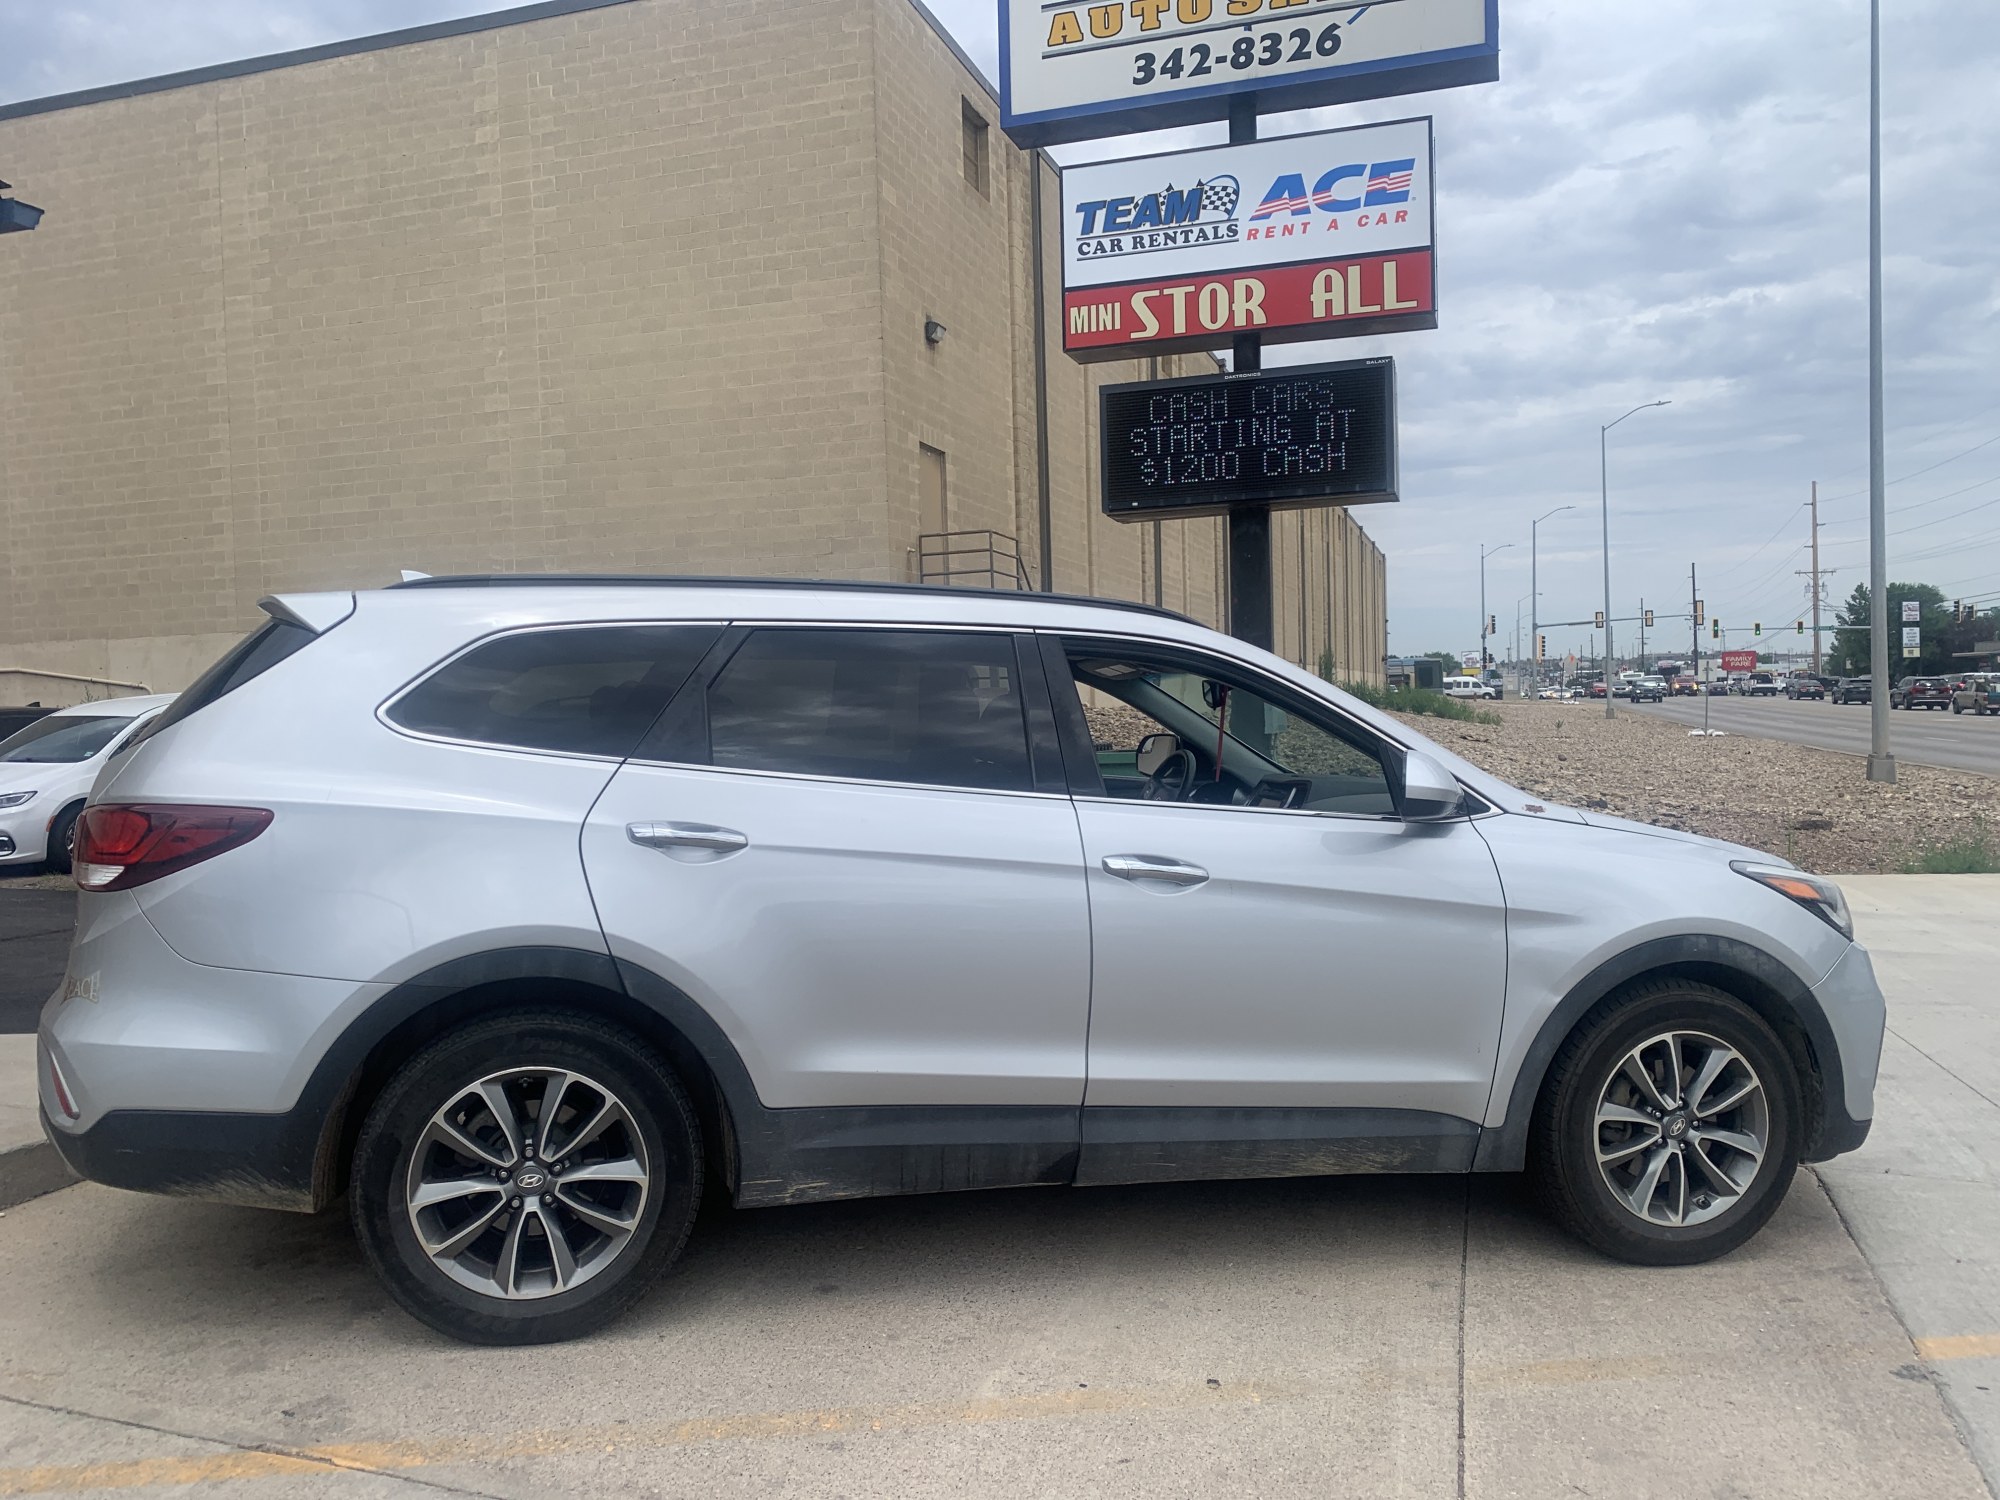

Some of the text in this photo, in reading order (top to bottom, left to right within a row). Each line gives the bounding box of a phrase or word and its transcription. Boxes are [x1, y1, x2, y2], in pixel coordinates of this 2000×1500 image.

[1047, 0, 1213, 47] AUTO
[1132, 22, 1342, 86] 342-8326
[1075, 187, 1205, 236] TEAM
[1248, 157, 1416, 222] ACE
[1077, 223, 1239, 256] CAR RENTALS
[1246, 209, 1409, 241] RENT A CAR
[1069, 260, 1419, 340] MINI STOR ALL
[1224, 371, 1262, 380] DAKTRONICS
[1149, 379, 1334, 424] CASH CARS
[1130, 408, 1356, 457] STARTING AT
[1140, 441, 1346, 486] $1200 CASH
